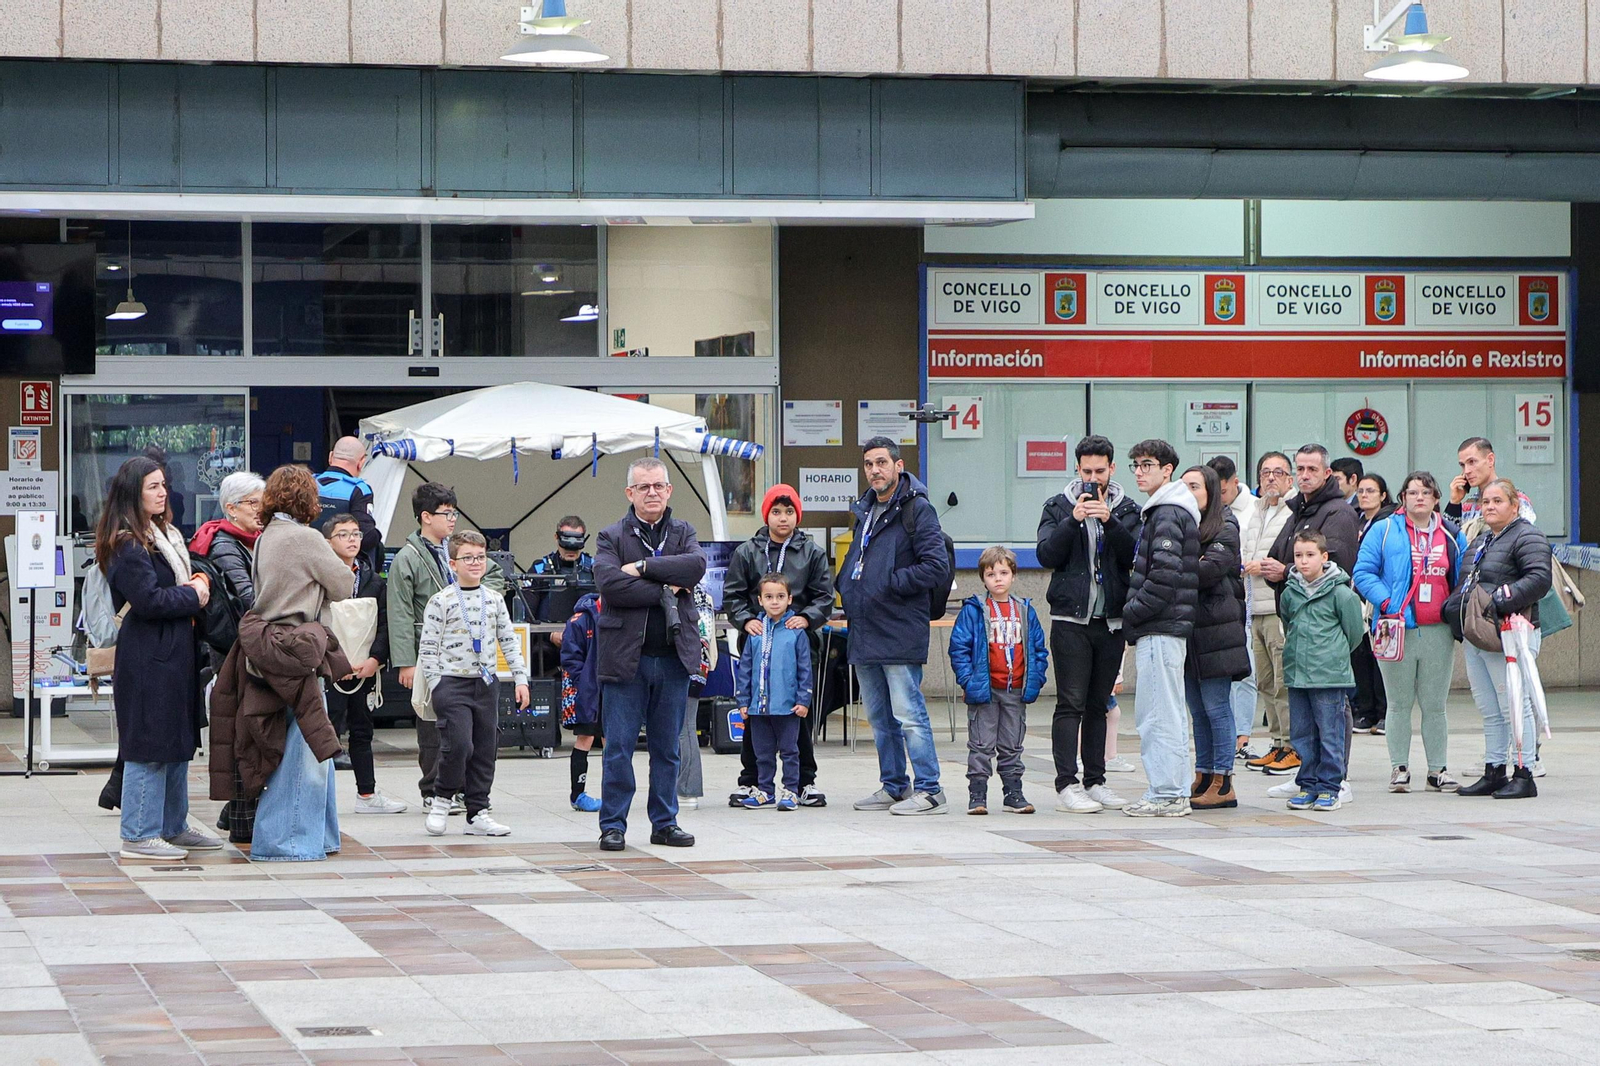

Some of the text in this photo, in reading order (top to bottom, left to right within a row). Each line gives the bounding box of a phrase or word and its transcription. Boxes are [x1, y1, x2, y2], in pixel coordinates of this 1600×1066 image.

[943, 282, 1031, 297] CONCELLO
[1104, 284, 1191, 298] CONCELLO
[1266, 285, 1352, 298] CONCELLO
[1422, 285, 1506, 299] CONCELLO
[953, 300, 1021, 314] DE VIGO
[1114, 301, 1181, 315] DE VIGO
[1277, 302, 1342, 315] DE VIGO
[1432, 302, 1497, 315] DE VIGO
[931, 349, 1043, 368] Información
[1360, 350, 1563, 368] Información e Rexistro
[947, 404, 980, 430] 14
[1518, 401, 1552, 427] 15
[805, 474, 852, 483] HORARIO
[814, 495, 830, 503] 9:00
